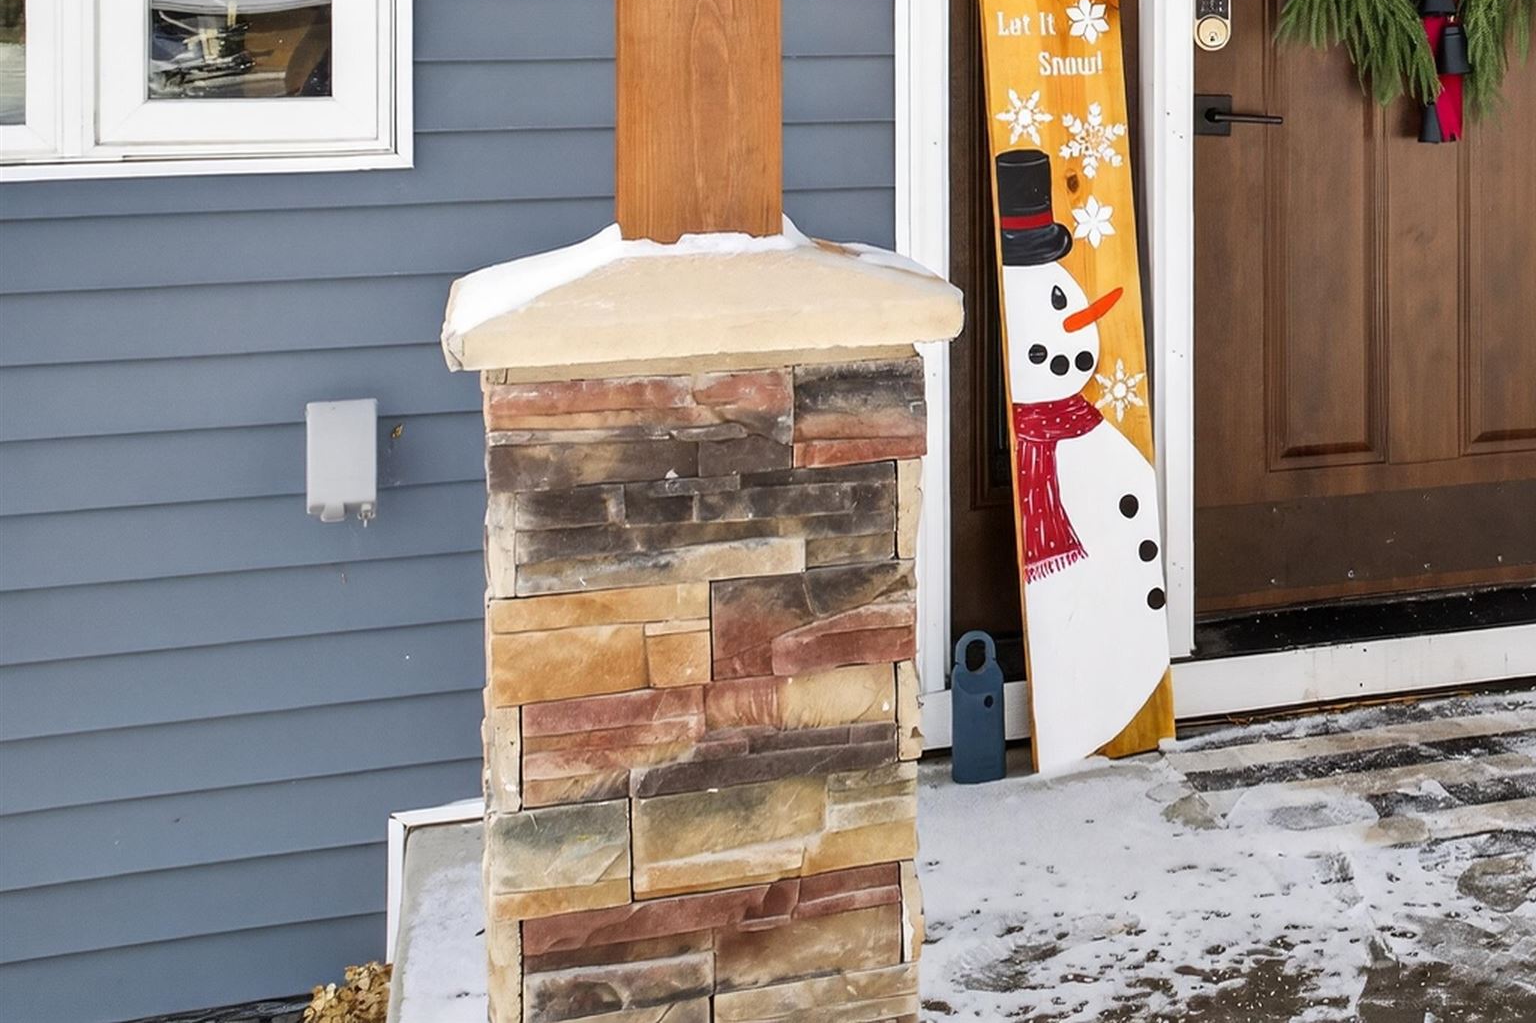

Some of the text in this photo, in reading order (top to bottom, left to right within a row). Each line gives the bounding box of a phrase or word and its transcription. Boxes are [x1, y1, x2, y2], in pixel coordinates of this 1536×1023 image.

[996, 11, 1056, 36] Let It
[1038, 50, 1104, 77] Snow!
